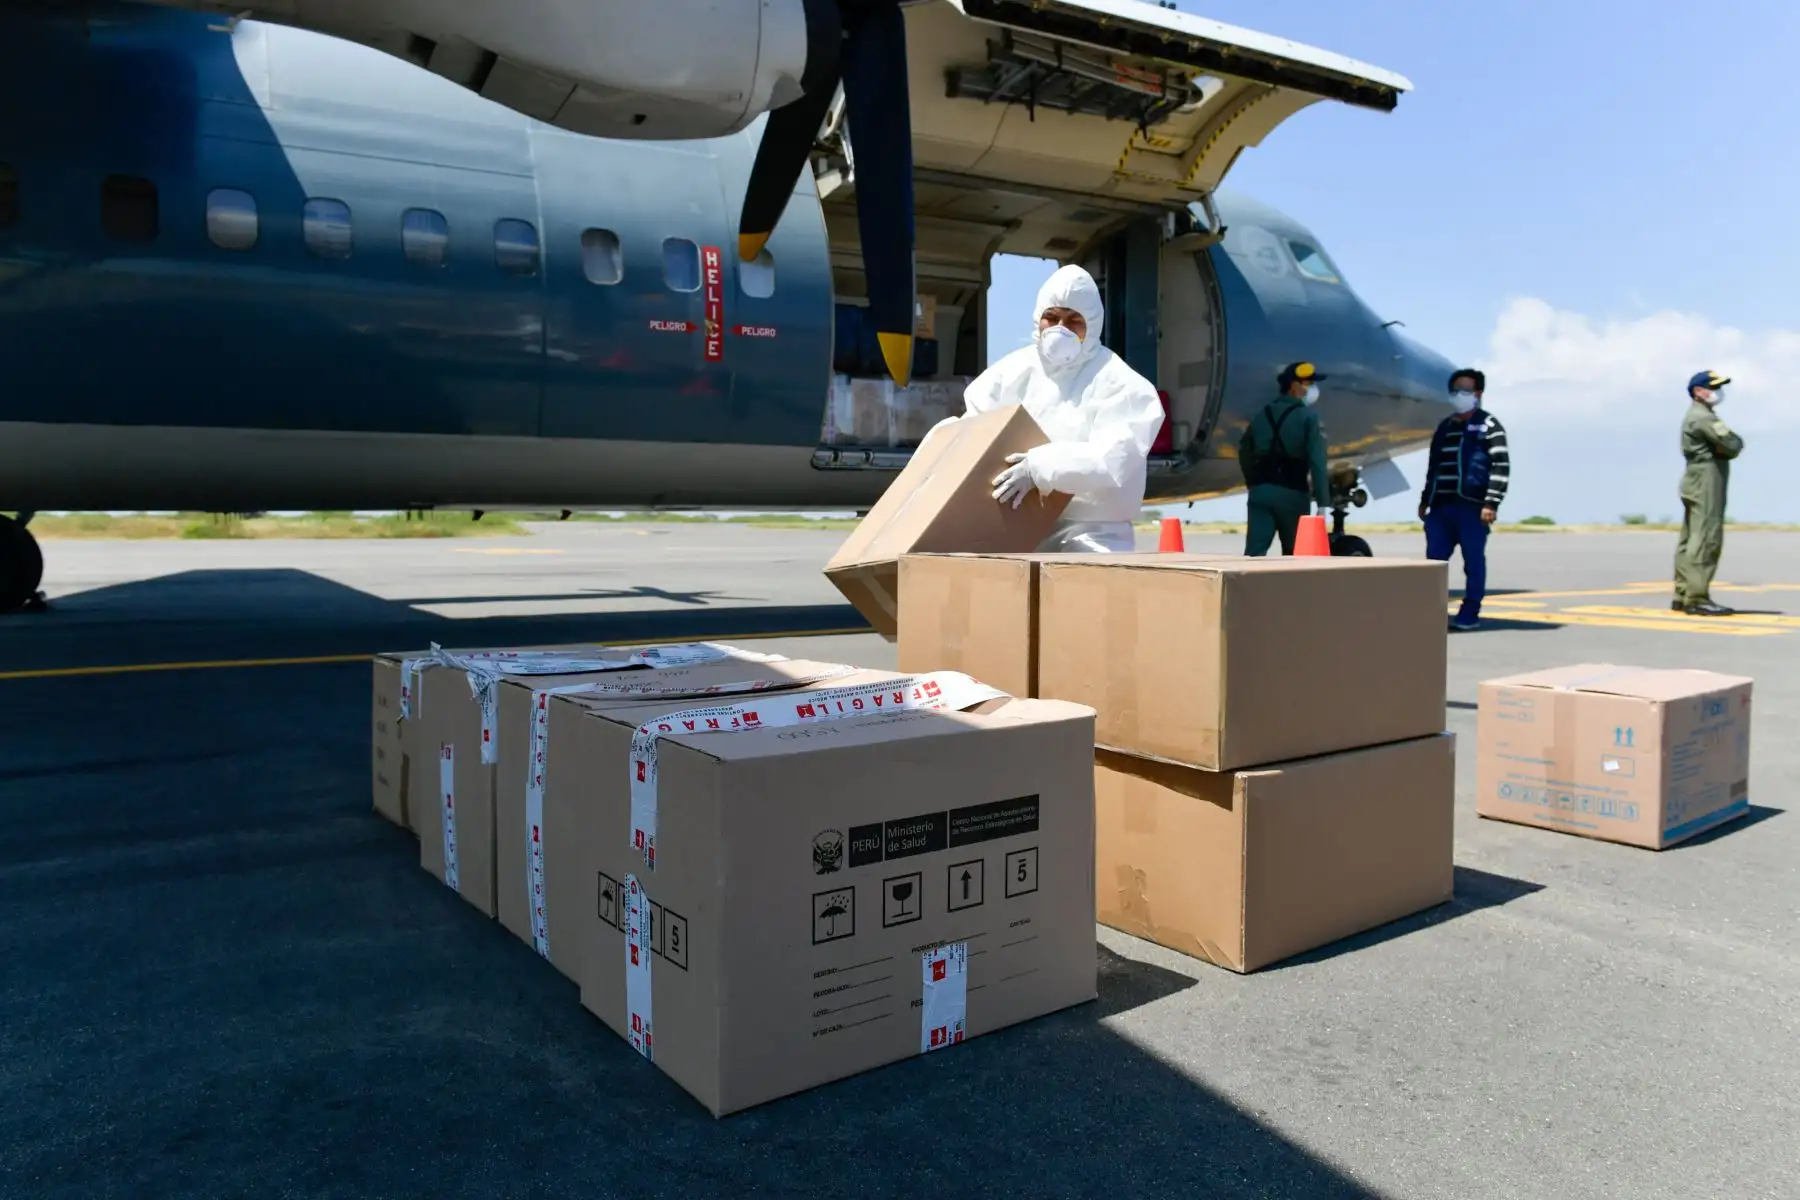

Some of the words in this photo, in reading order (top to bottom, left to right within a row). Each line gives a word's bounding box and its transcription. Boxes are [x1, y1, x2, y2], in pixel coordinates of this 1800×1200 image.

[705, 251, 719, 356] HELICE
[650, 320, 687, 332] PELIGRO
[741, 326, 777, 338] PELIGRO
[817, 688, 923, 714] FRAGIL
[887, 819, 935, 839] Ministerio
[851, 833, 881, 853] PERÚ
[887, 840, 900, 853] de
[900, 836, 927, 851] Salud
[1017, 861, 1028, 883] 5
[671, 922, 681, 946] 5
